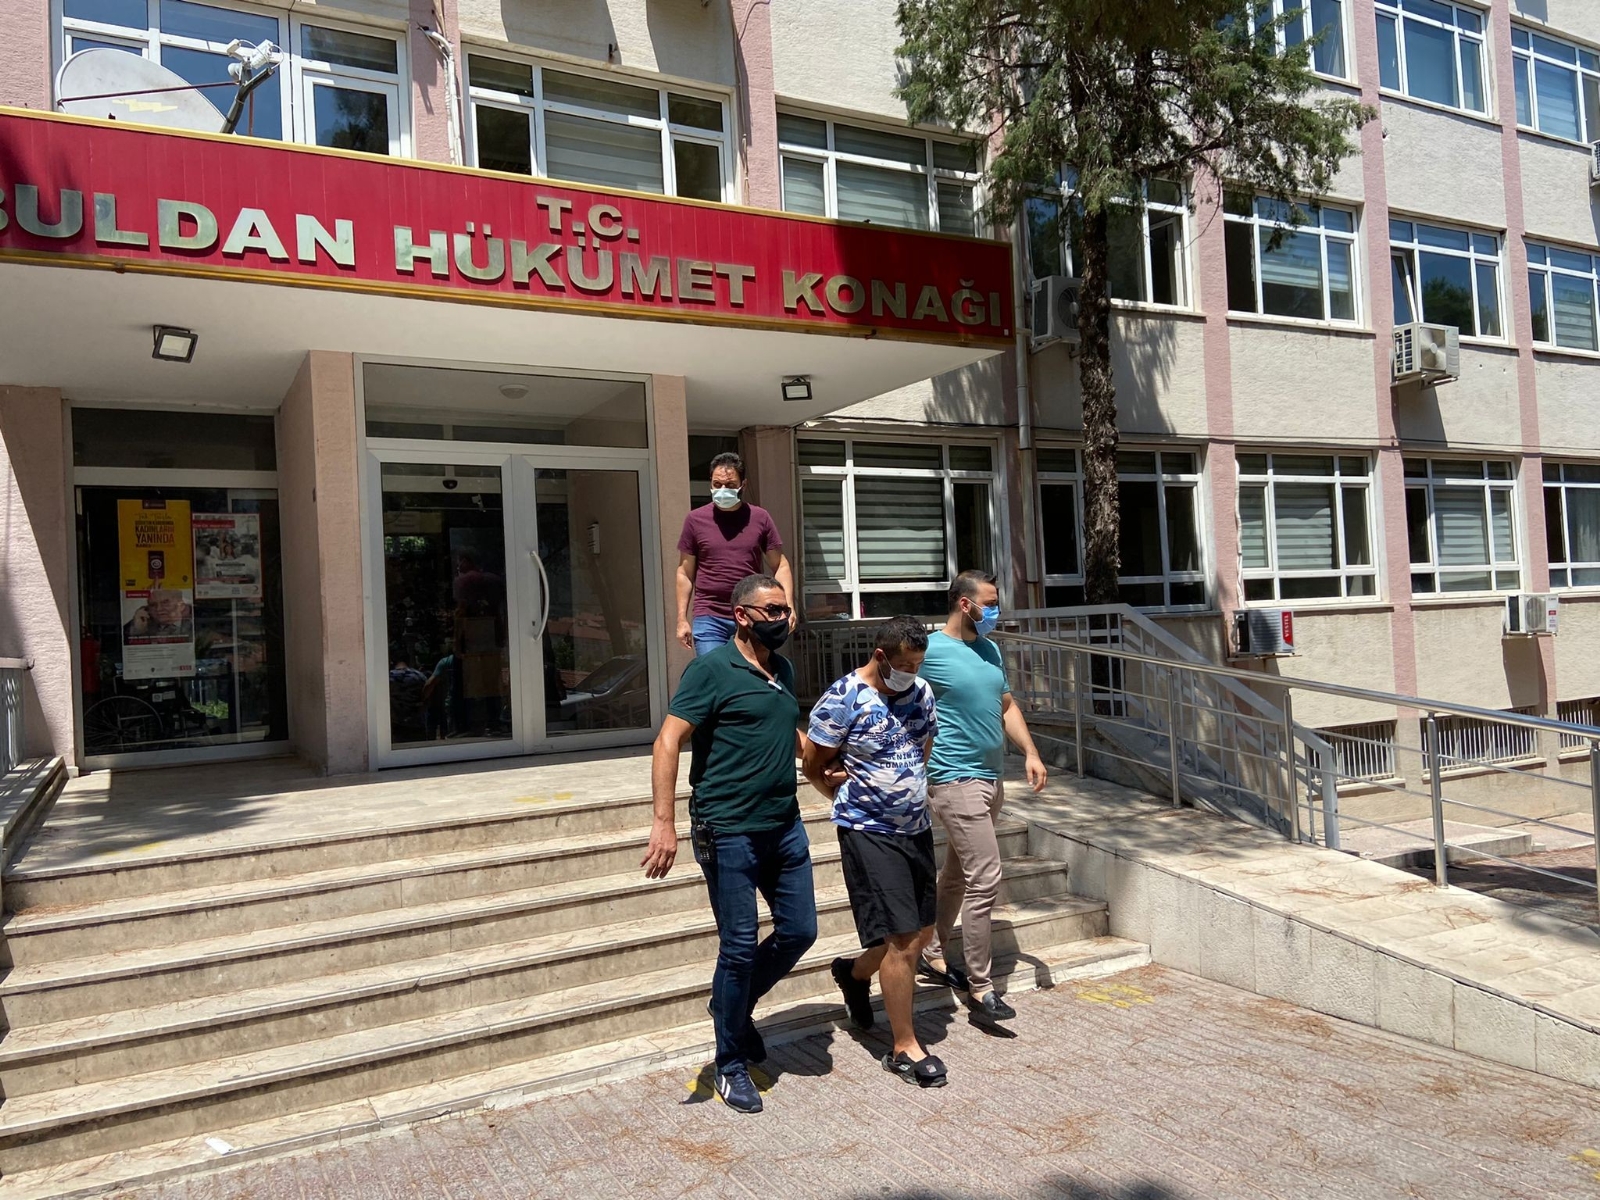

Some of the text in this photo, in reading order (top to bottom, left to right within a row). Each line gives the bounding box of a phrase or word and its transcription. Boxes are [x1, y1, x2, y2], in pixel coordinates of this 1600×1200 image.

[535, 195, 640, 242] T.C.
[0, 183, 1002, 327] ULDAN HÜKÜMET KONAĞI
[136, 533, 174, 544] YANINDA
